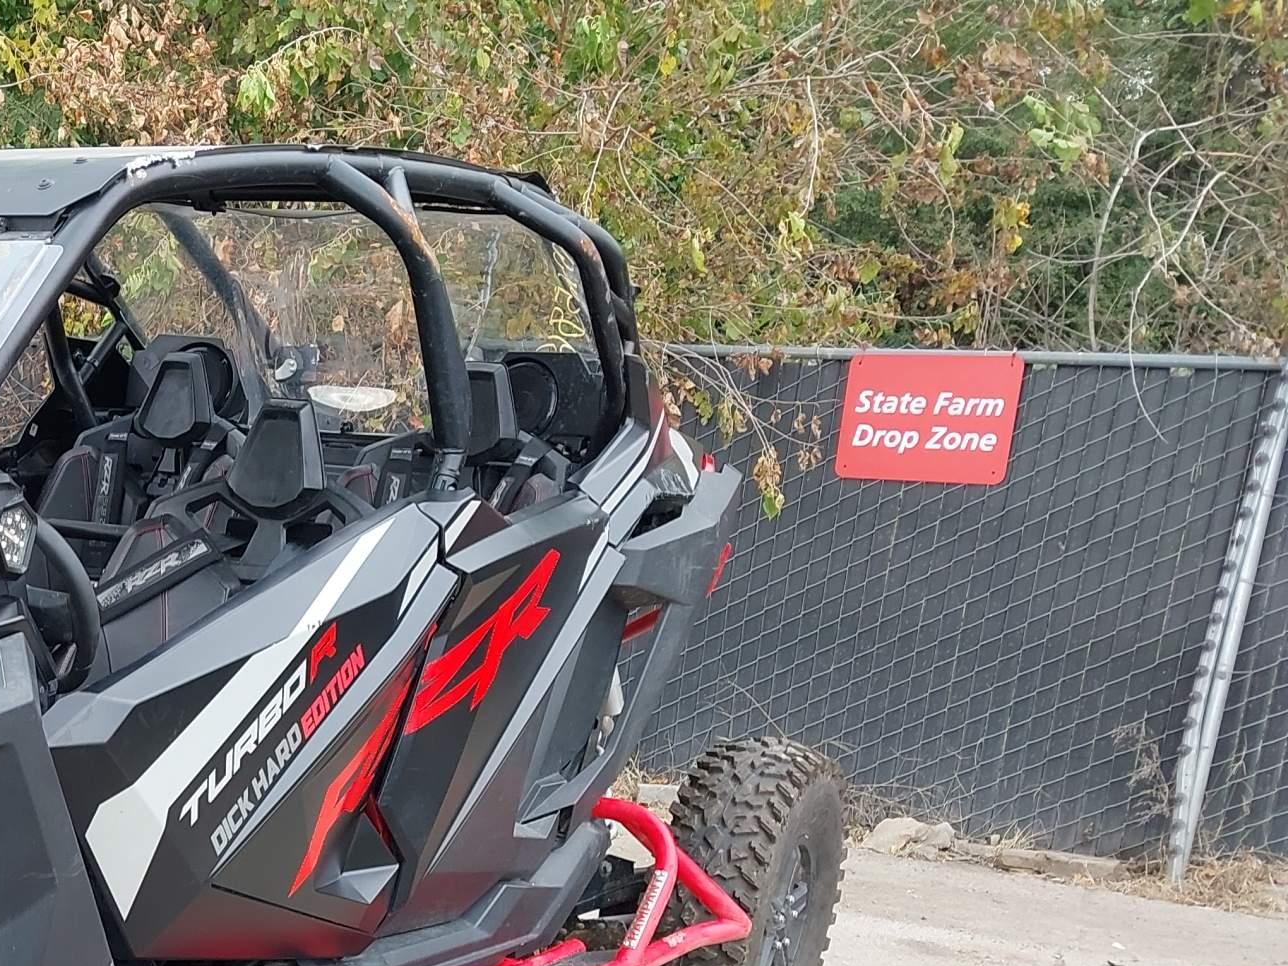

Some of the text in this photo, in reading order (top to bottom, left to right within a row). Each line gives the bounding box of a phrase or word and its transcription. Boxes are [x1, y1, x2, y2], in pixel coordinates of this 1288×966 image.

[852, 424, 998, 454] Drop Zone
[855, 390, 1005, 417] State Farm
[178, 621, 338, 828] TURBO R
[210, 643, 366, 857] DICK HARD EDITION
